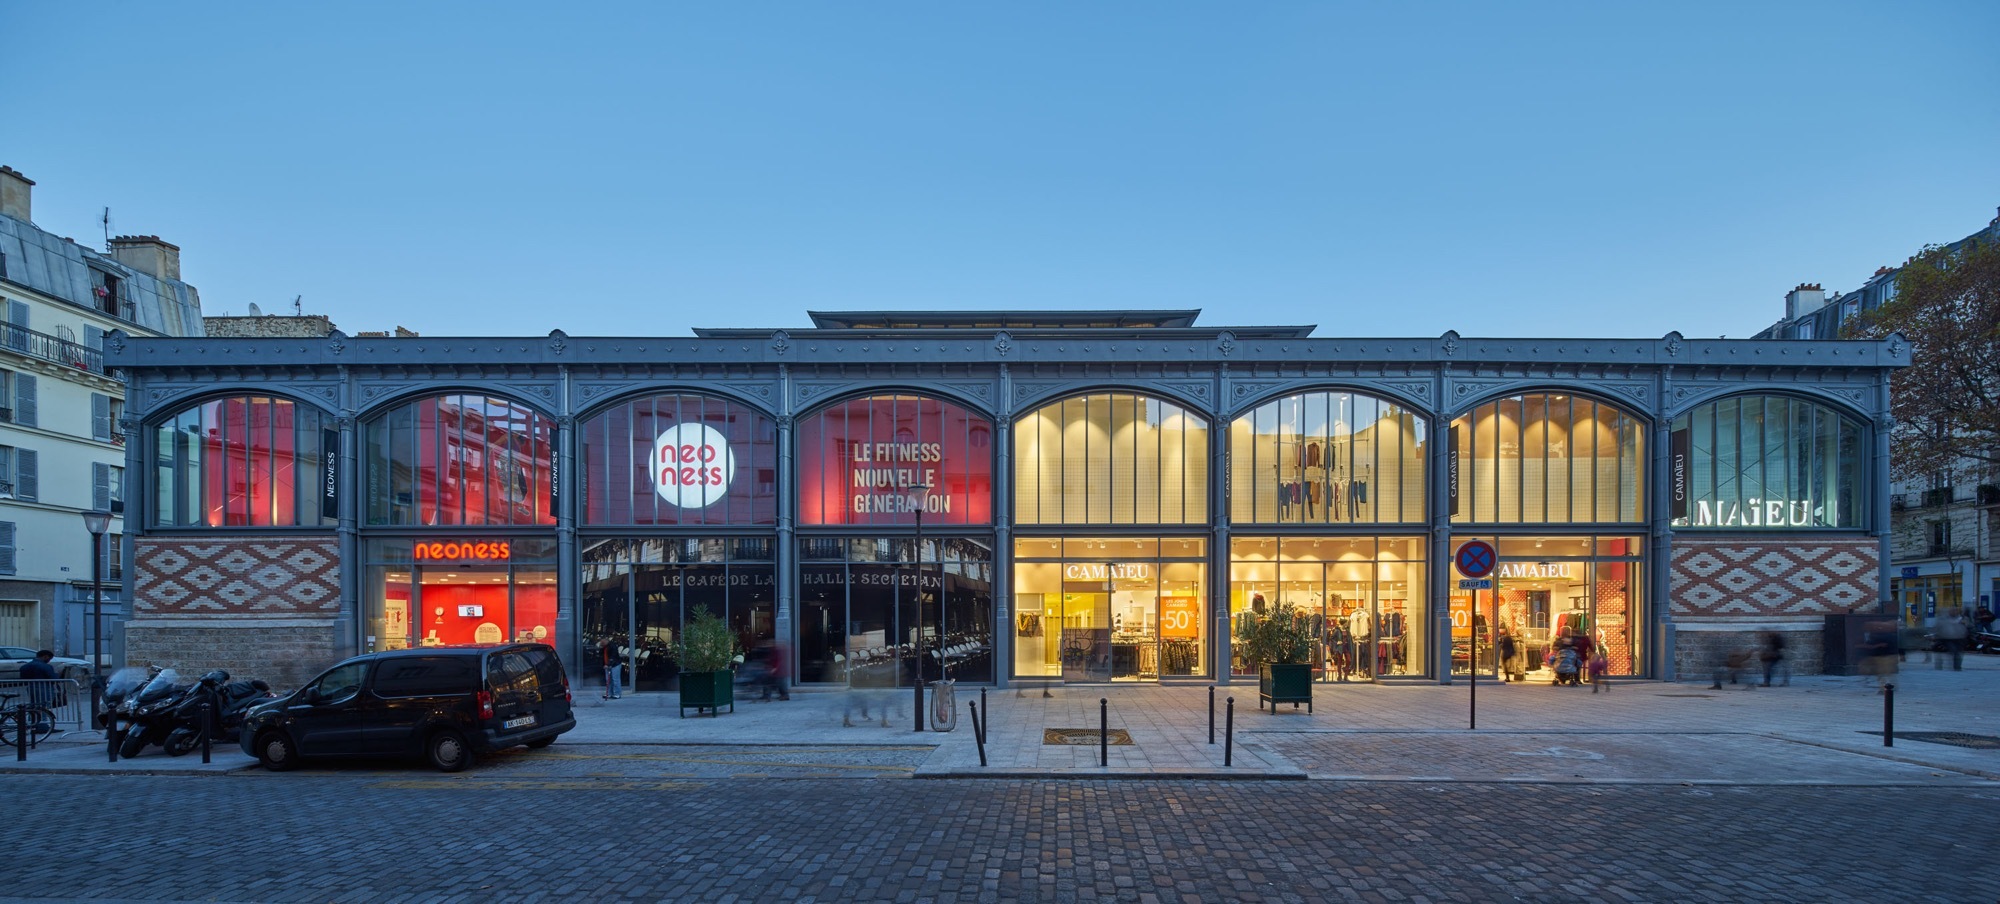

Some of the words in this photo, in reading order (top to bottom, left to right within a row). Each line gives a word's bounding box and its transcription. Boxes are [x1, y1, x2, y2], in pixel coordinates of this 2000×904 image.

[661, 444, 716, 463] neo
[854, 443, 871, 462] LE
[876, 443, 941, 462] FITNESS
[327, 451, 335, 497] NEONESS
[661, 466, 722, 486] ness
[854, 469, 935, 487] NOUVELLE
[1449, 450, 1457, 498] CAMAÏEU
[1674, 454, 1684, 501] CAMAÏEU
[415, 542, 510, 559] neoness
[662, 575, 681, 587] LE
[686, 573, 726, 587] CAFÉ
[729, 574, 749, 586] DE
[754, 574, 775, 585] LA
[803, 573, 856, 584] HALLE
[1490, 563, 1571, 578] AMAïEU
